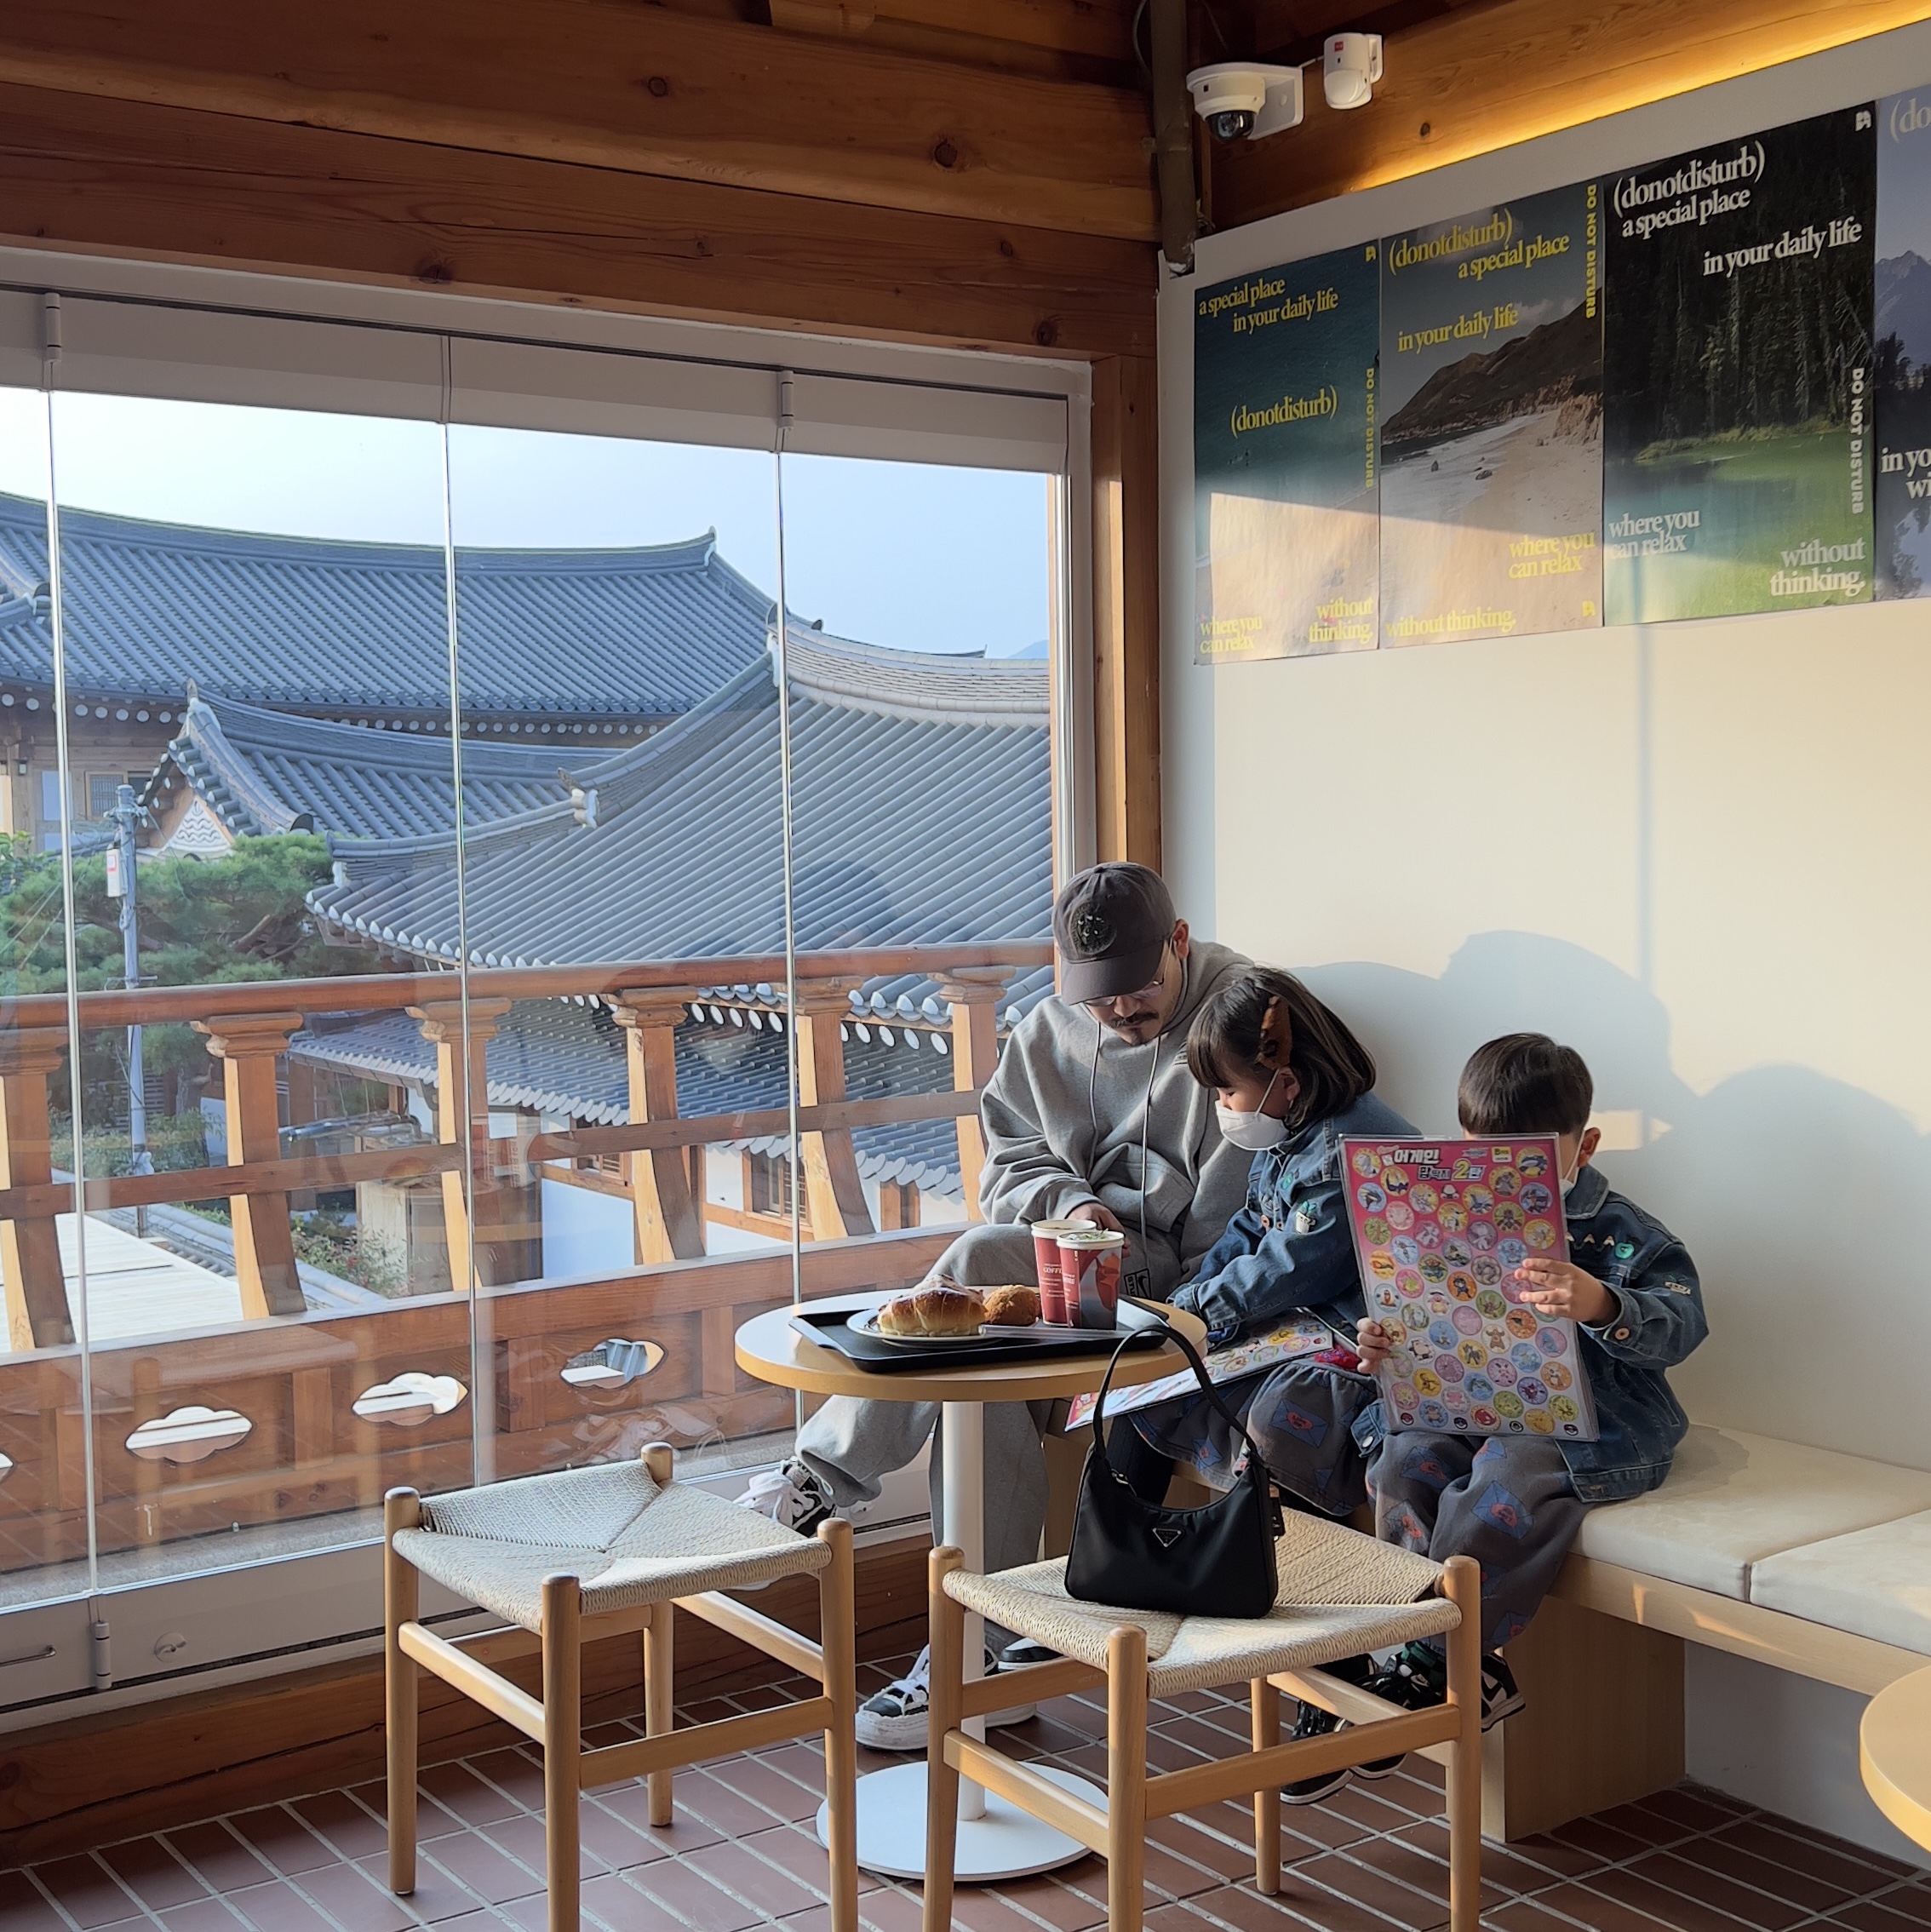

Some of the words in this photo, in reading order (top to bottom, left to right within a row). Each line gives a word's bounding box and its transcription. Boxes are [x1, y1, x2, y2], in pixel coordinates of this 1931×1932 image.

[1613, 140, 1766, 218] (donotdisturb)
[1587, 183, 1597, 209] DO
[1587, 212, 1597, 246] NOT
[1622, 220, 1634, 238] a
[1636, 195, 1698, 240] special
[1699, 188, 1751, 226] place
[1389, 208, 1513, 276] (donotdisturb)
[1458, 262, 1468, 279] a
[1470, 239, 1523, 281] special
[1525, 234, 1570, 268] place
[1704, 250, 1724, 276] in
[1724, 243, 1775, 278] your
[1774, 225, 1827, 259] daily
[1828, 215, 1863, 248] life
[1199, 301, 1207, 315] a
[1208, 282, 1249, 318] special
[1250, 278, 1286, 308] place
[1586, 249, 1596, 318] DISTURB
[1233, 312, 1247, 332] in
[1247, 307, 1281, 335] your
[1281, 294, 1315, 321] daily
[1316, 287, 1338, 312] life
[1398, 330, 1413, 352] in
[1414, 324, 1454, 355] your
[1453, 311, 1493, 339] daily
[1493, 303, 1519, 330] life
[1366, 368, 1374, 390] DO
[1852, 368, 1865, 394] DO
[1231, 384, 1338, 439] (donotdisturb)
[1366, 393, 1374, 423] NOT
[1850, 398, 1864, 436] NOT
[1366, 427, 1374, 489] DISTURB
[1881, 447, 1905, 473] in
[1850, 439, 1865, 514] DISTURB
[1609, 513, 1664, 537] where
[1663, 509, 1700, 537] you
[1509, 534, 1561, 558] where
[1560, 532, 1595, 558] you
[1611, 541, 1638, 559] can
[1642, 531, 1687, 555] relax
[1780, 537, 1866, 568] without
[1509, 562, 1538, 579] can
[1541, 553, 1583, 576] relax
[1315, 597, 1374, 619] without
[1199, 616, 1239, 636] where
[1239, 616, 1263, 638] you
[1385, 613, 1444, 637] without
[1199, 639, 1223, 654] can
[1225, 631, 1254, 651] relax
[1394, 1149, 1440, 1165] 어게인
